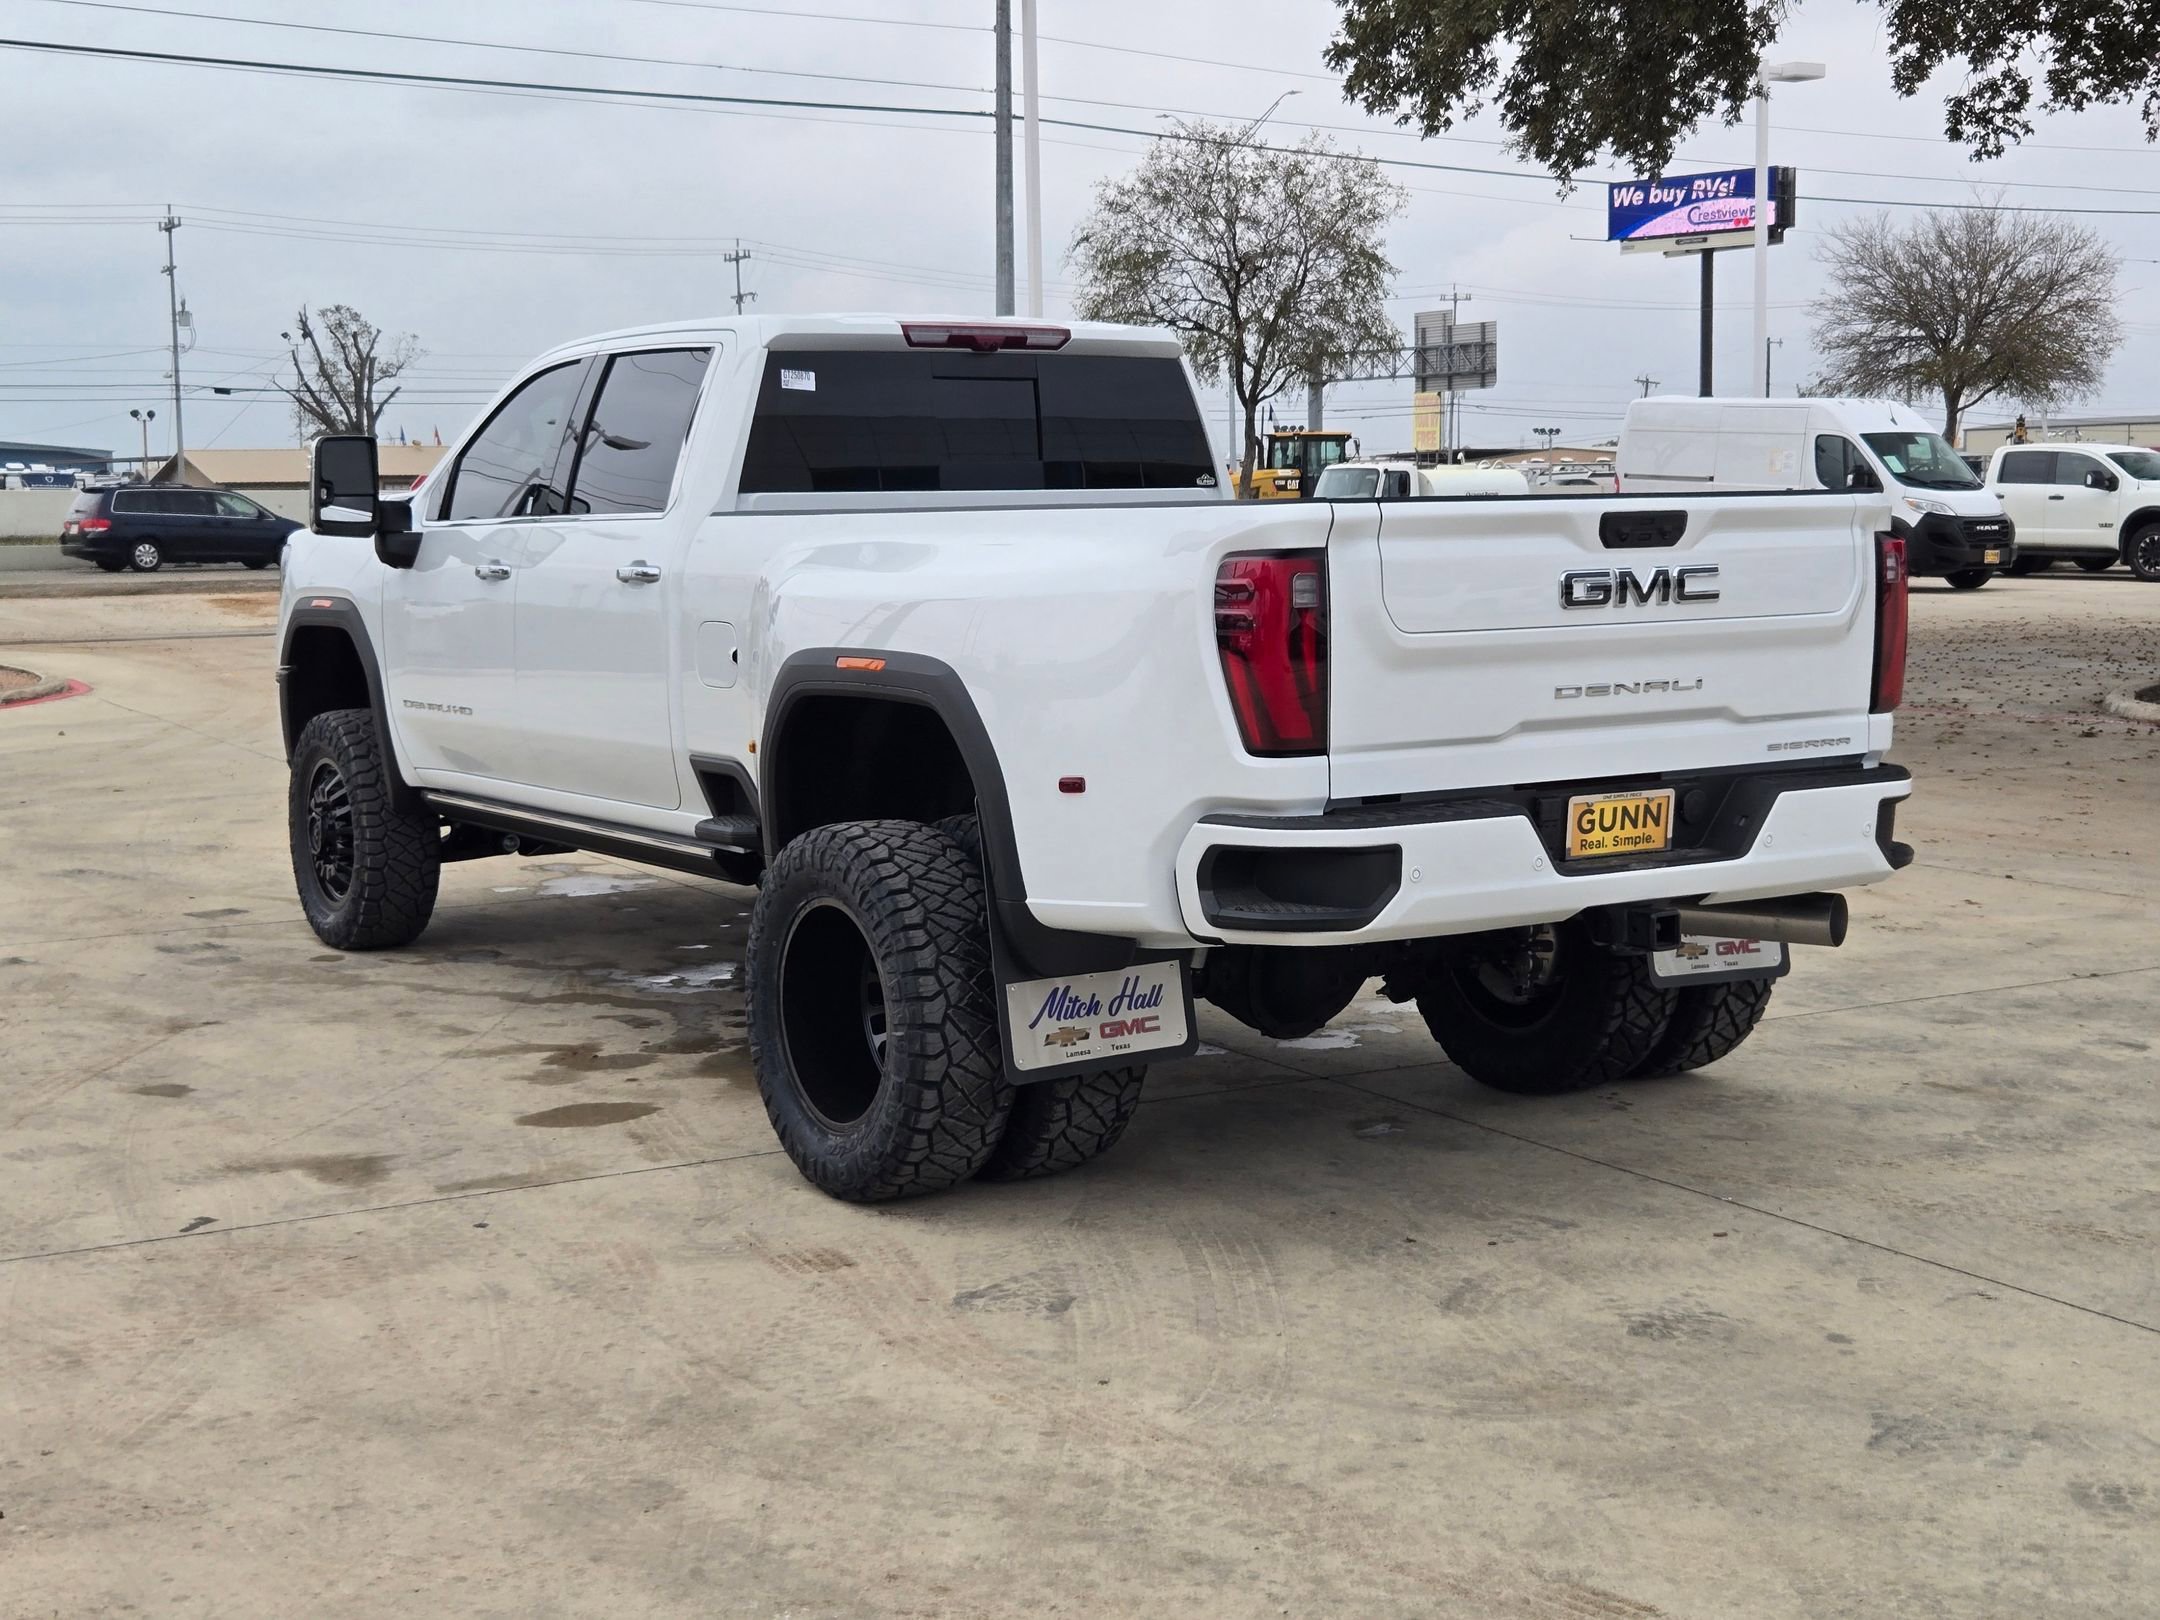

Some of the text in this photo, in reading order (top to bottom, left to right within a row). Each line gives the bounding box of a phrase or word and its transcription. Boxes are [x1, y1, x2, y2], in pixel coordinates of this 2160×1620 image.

[1613, 176, 1737, 208] We buy RVs!
[1287, 479, 1300, 490] CAT
[1559, 563, 1720, 609] GMC
[1554, 677, 1703, 700] DENALI
[1767, 737, 1851, 751] SIERRA
[1577, 802, 1662, 835] GUNN
[1580, 832, 1655, 850] Real. Simple.
[1715, 940, 1761, 956] GMC
[1028, 975, 1163, 1030] Mitch Hall
[1099, 1015, 1161, 1039] GMC
[1065, 1042, 1131, 1059] Lamesa Texas
